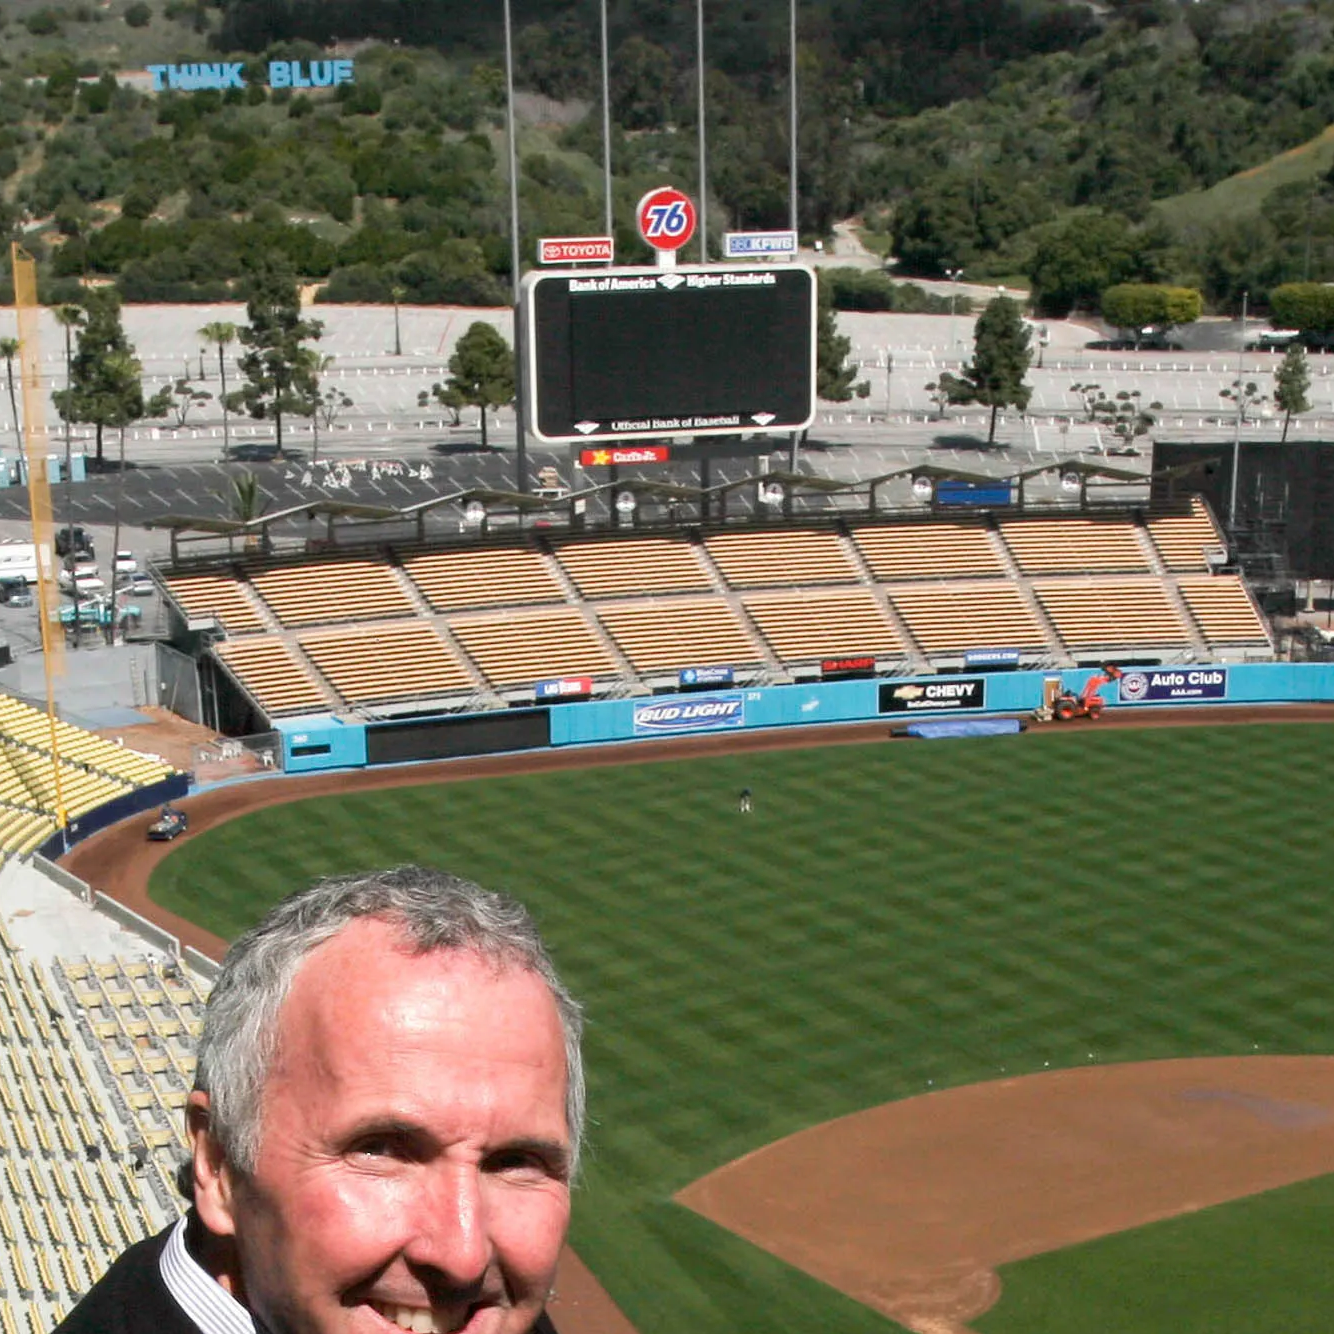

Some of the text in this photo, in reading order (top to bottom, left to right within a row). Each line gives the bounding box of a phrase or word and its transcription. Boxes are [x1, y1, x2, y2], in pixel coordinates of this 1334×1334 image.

[146, 59, 354, 91] THINK BLUE
[646, 200, 687, 237] 76
[561, 244, 611, 256] TOYOTA
[569, 277, 657, 292] Bank of America
[686, 273, 776, 288] Higher Standards
[652, 418, 680, 429] Bank
[681, 417, 692, 427] of
[694, 415, 740, 426] Baseball
[1151, 674, 1184, 686] Auto
[1188, 672, 1223, 685] Club
[926, 684, 975, 697] CHEVY
[640, 702, 740, 721] BUD LIGHT
